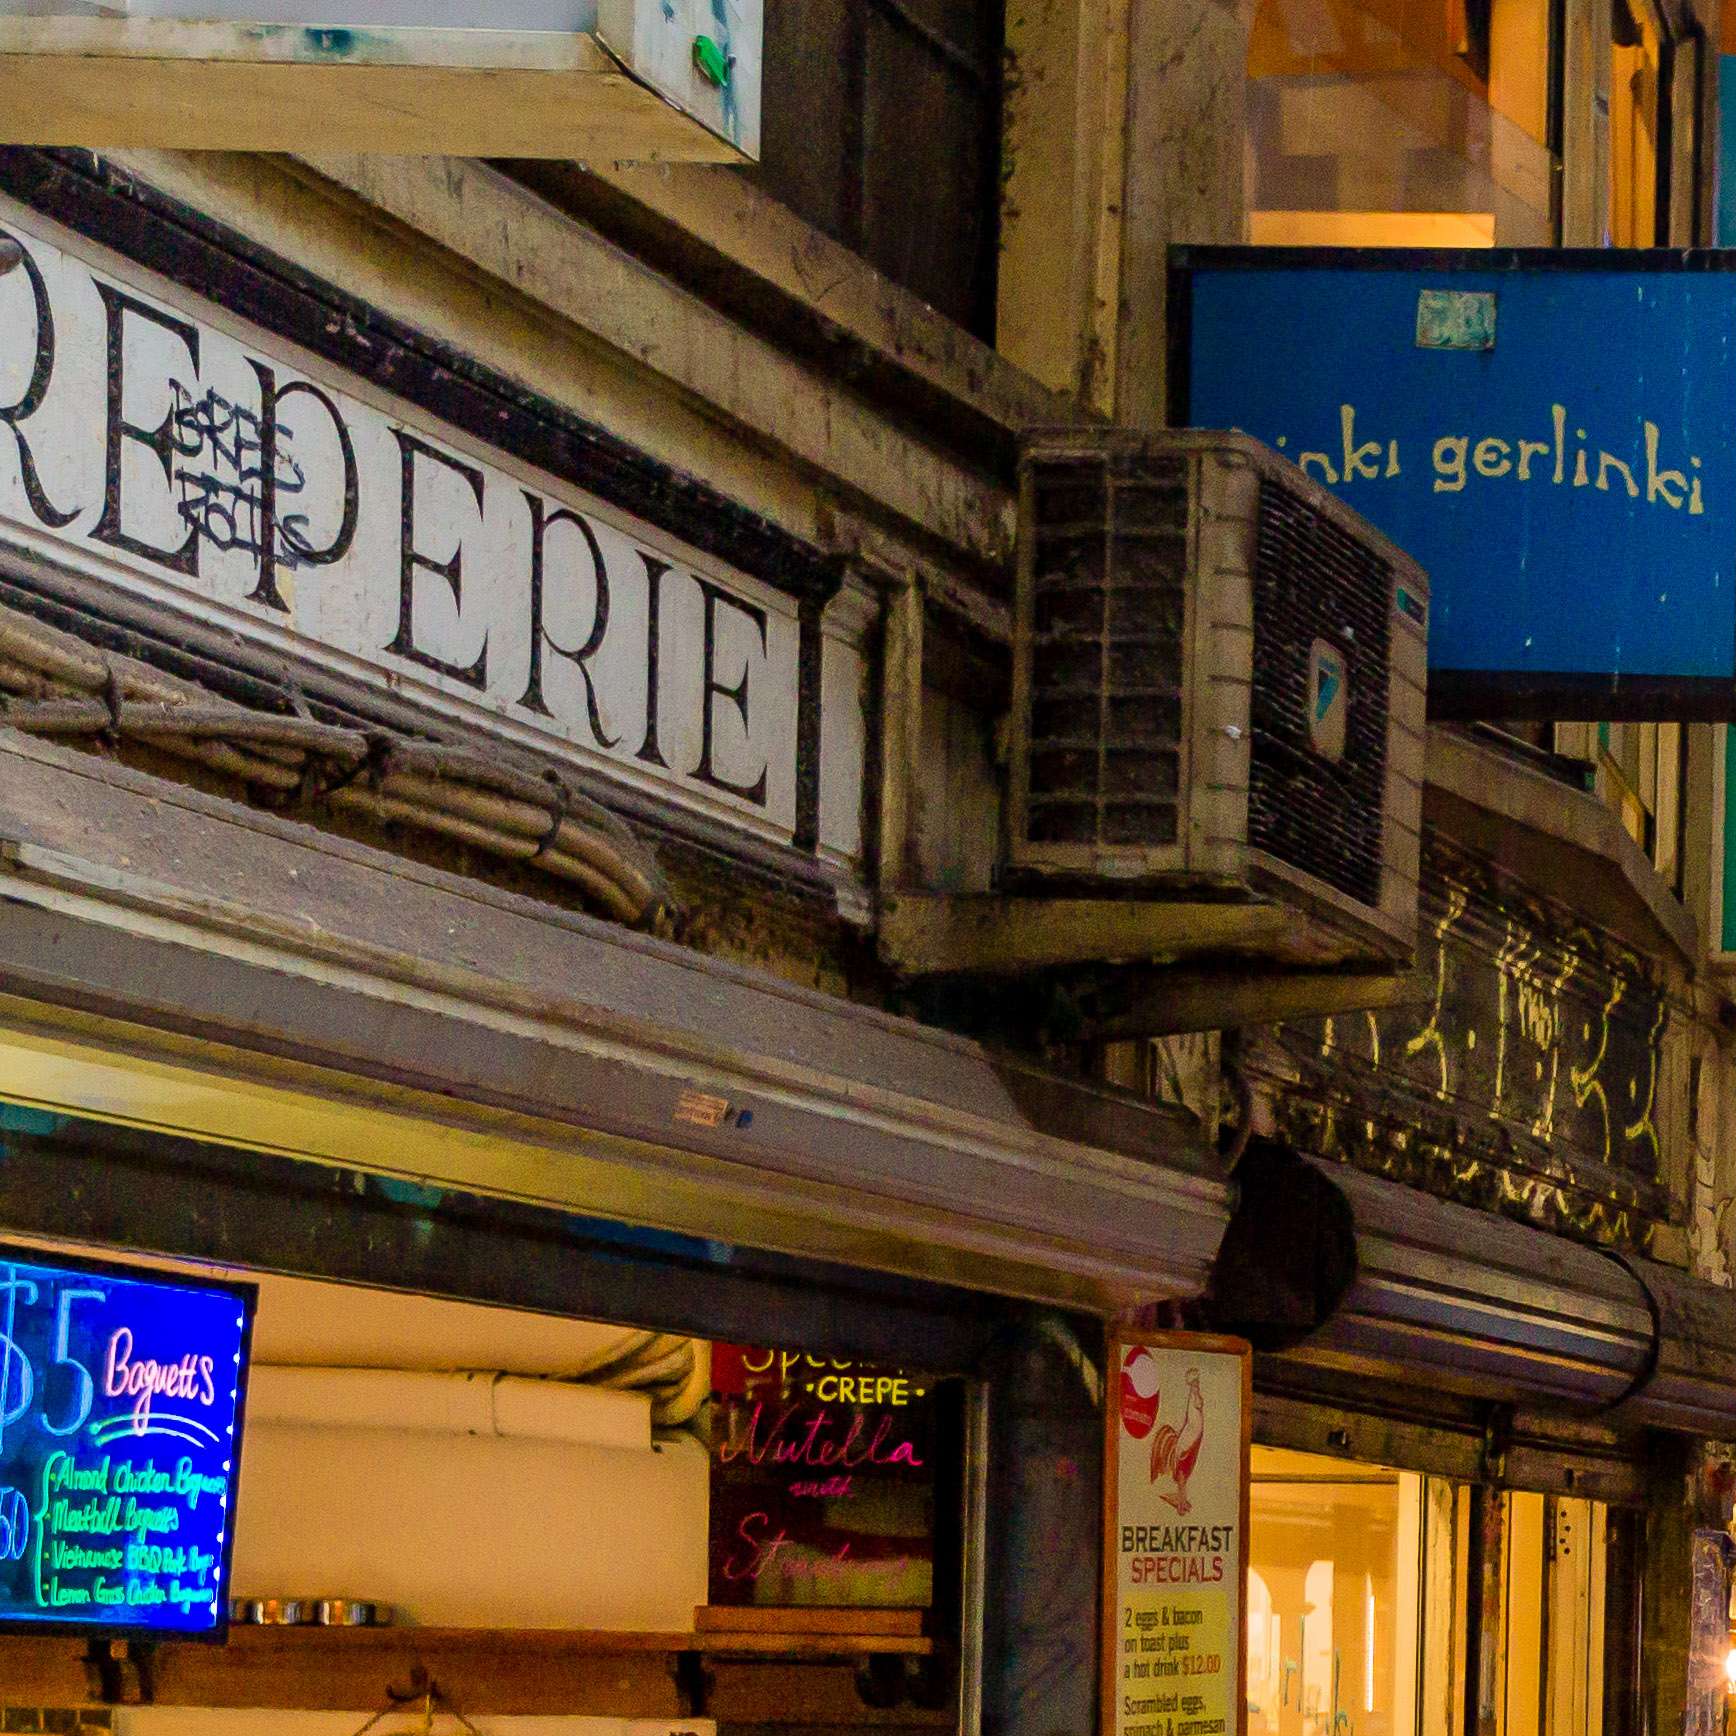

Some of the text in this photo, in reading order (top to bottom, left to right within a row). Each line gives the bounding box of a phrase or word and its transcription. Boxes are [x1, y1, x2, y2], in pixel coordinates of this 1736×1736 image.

[816, 1375, 909, 1406] CREPE
[720, 1402, 924, 1470] Nutella
[1121, 1525, 1234, 1553] BREAKFAST
[1131, 1555, 1225, 1584] SPECIALS
[1136, 1610, 1158, 1633] eggs
[1161, 1607, 1170, 1627] &
[1173, 1605, 1204, 1627] bacon
[1124, 1629, 1190, 1654] on toast plus
[1133, 1660, 1151, 1679] hot
[1153, 1657, 1180, 1677] drink
[1181, 1654, 1222, 1677] $12.00
[1124, 1694, 1179, 1718] Scrambled
